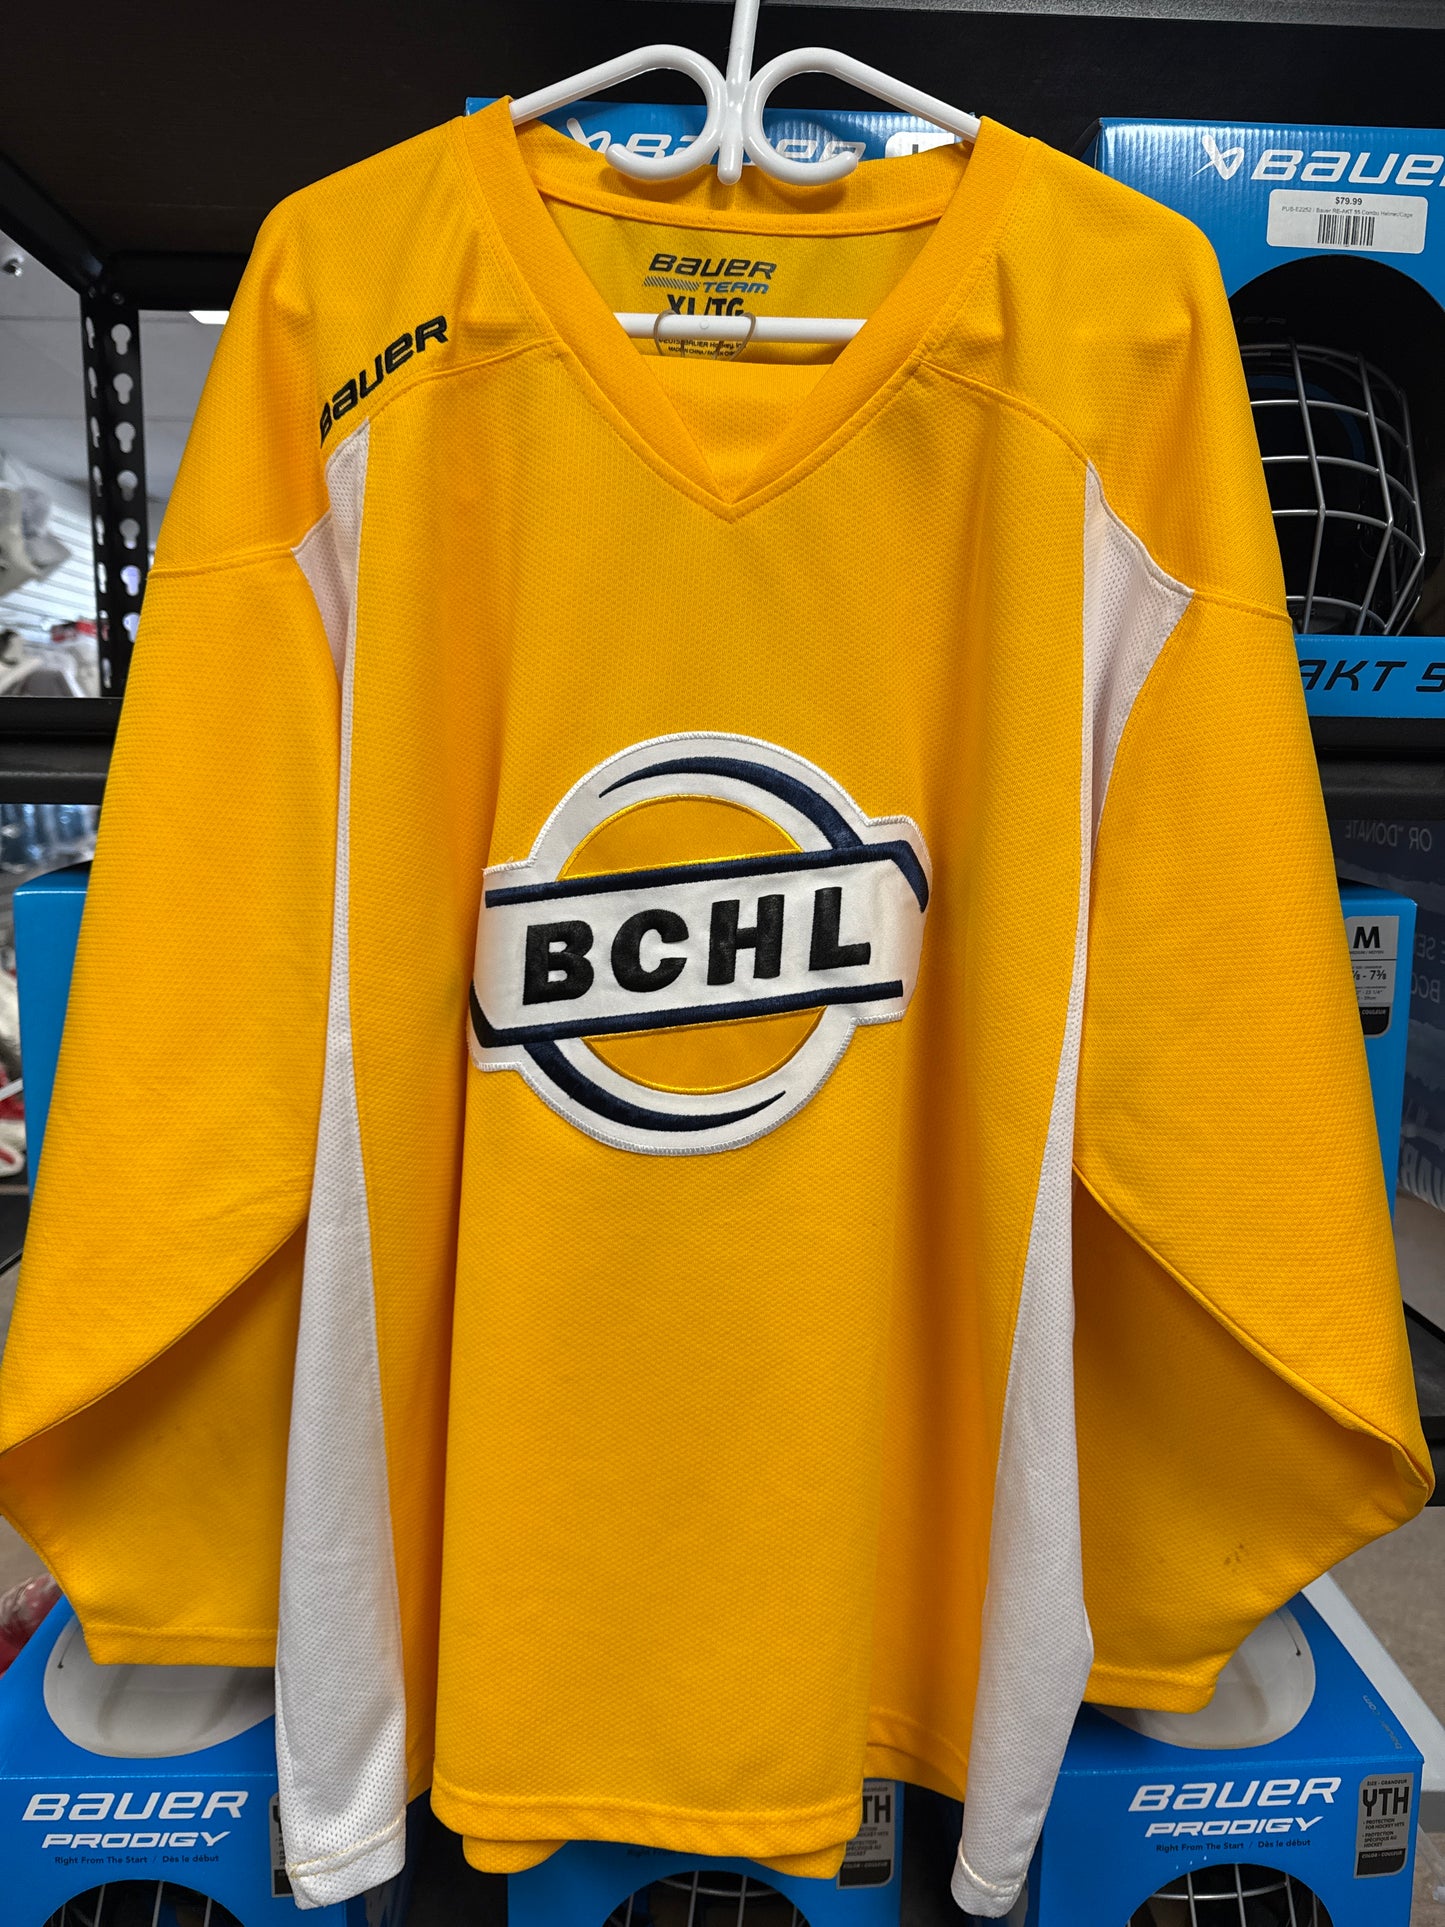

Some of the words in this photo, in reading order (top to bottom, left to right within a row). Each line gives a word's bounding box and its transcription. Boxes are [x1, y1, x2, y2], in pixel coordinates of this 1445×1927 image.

[1250, 149, 1445, 187] BAUE
[1335, 197, 1363, 206] $79.99
[703, 282, 770, 294] TEAM
[523, 886, 871, 1005] BCHL
[1353, 926, 1381, 948] M
[863, 1795, 891, 1823] TH
[1363, 1786, 1409, 1817] YTH
[1145, 1816, 1324, 1838] PRODIGY
[41, 1831, 231, 1849] PRODIGY
[1156, 1843, 1179, 1854] Right
[1181, 1843, 1203, 1851] From
[1206, 1843, 1221, 1851] The
[1224, 1841, 1245, 1850] Start
[1258, 1840, 1274, 1849] Dès
[1276, 1839, 1284, 1848] le
[1286, 1838, 1311, 1848] début
[55, 1856, 78, 1866] Right
[81, 1856, 104, 1864] From
[107, 1856, 123, 1864] The
[126, 1855, 148, 1864] Start
[162, 1855, 179, 1863] Dès
[181, 1855, 190, 1863] le
[192, 1854, 219, 1863] début
